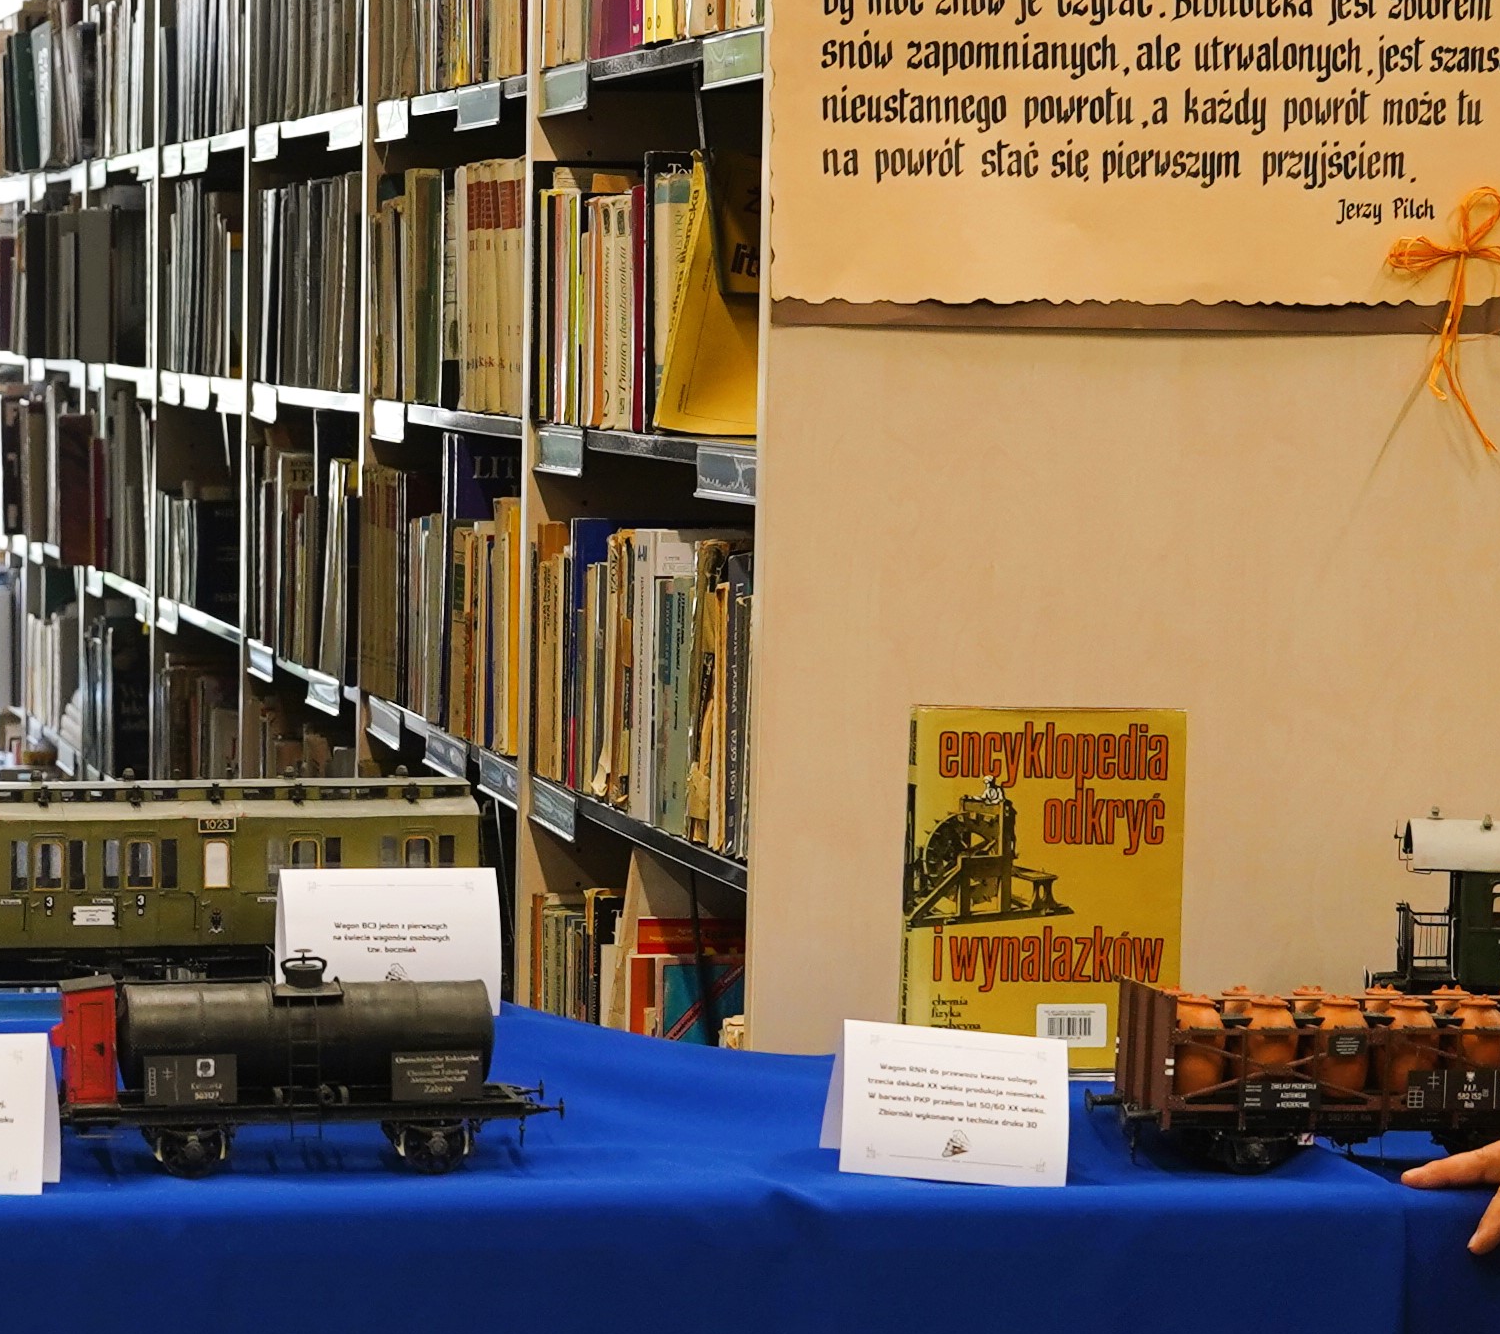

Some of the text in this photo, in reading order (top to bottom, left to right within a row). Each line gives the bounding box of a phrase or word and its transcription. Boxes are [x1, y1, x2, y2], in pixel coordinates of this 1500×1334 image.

[821, 29, 893, 70] snów
[1136, 34, 1181, 72] ale
[1375, 34, 1426, 85] jest
[822, 148, 859, 177] na
[874, 137, 966, 184] powrót
[981, 139, 1039, 179] stać
[1050, 138, 1090, 183] się
[1102, 140, 1241, 189] pierwszym
[1335, 197, 1435, 226] Jerzy Pilch
[938, 721, 1169, 789] encyklopedia
[205, 819, 231, 831] 1023
[1042, 788, 1165, 855] odkryć
[46, 896, 54, 908] 3
[137, 895, 145, 907] 3
[932, 924, 1165, 993] i wynalazków
[931, 993, 968, 1006] chemia
[931, 1006, 962, 1022] fizyka
